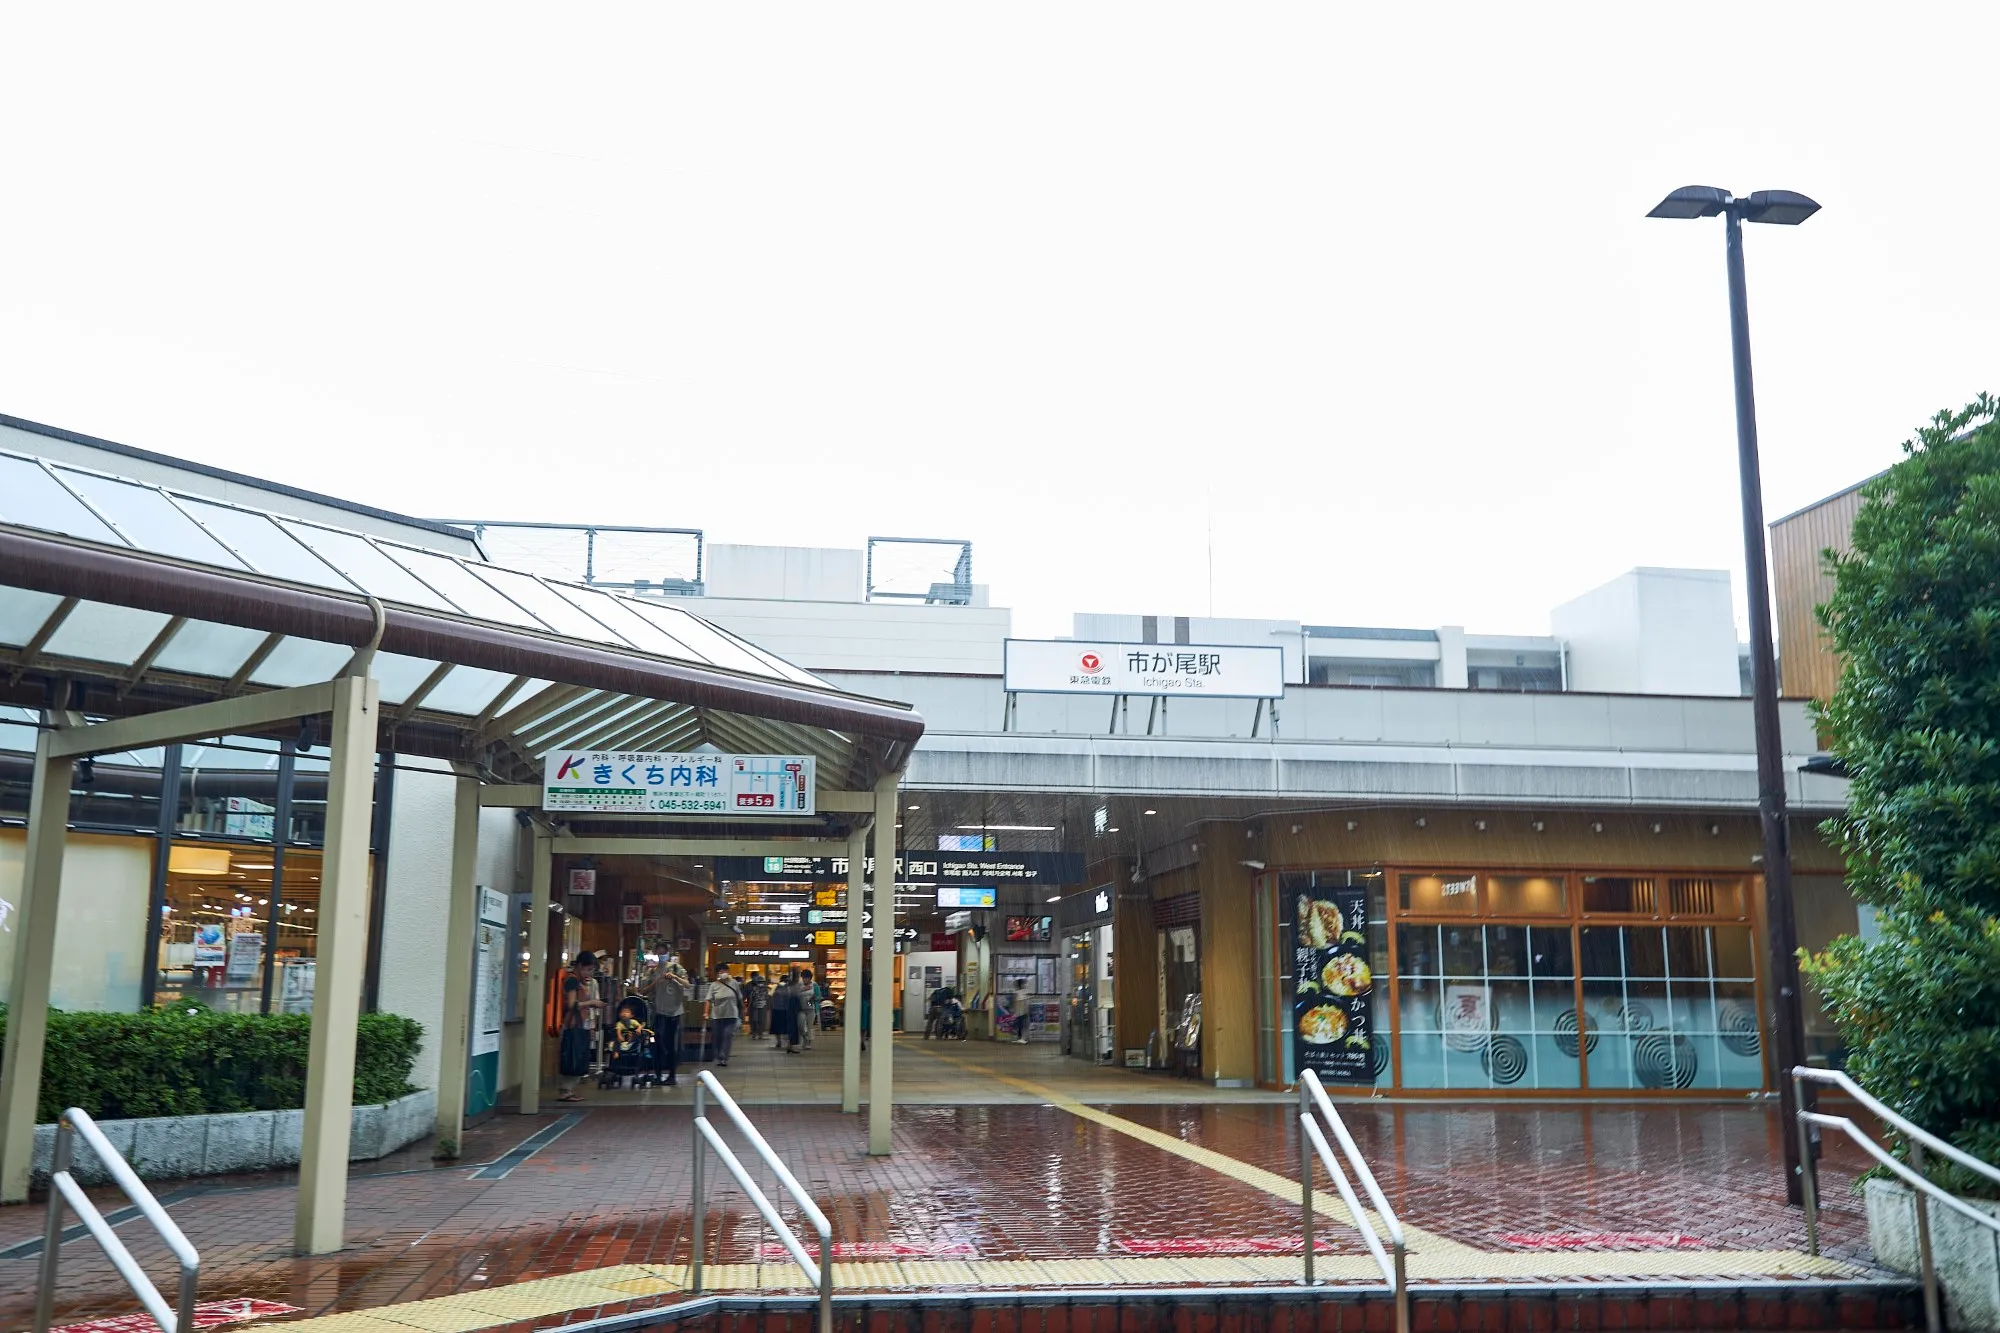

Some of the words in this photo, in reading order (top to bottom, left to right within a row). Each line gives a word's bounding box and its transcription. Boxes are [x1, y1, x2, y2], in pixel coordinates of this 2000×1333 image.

[1127, 651, 1221, 675] 市が尾駅
[1070, 675, 1111, 685] 東急電鉄
[1143, 677, 1182, 689] Ichigao
[1185, 678, 1205, 688] Sta.
[594, 764, 718, 787] きくち内科
[659, 800, 726, 810] 045-532-5941
[738, 796, 771, 806] 徒歩5分
[909, 861, 937, 876] 西口
[942, 862, 966, 870] Ichigao
[1349, 899, 1365, 930] 天丼
[1350, 997, 1367, 1049] かつ丼
